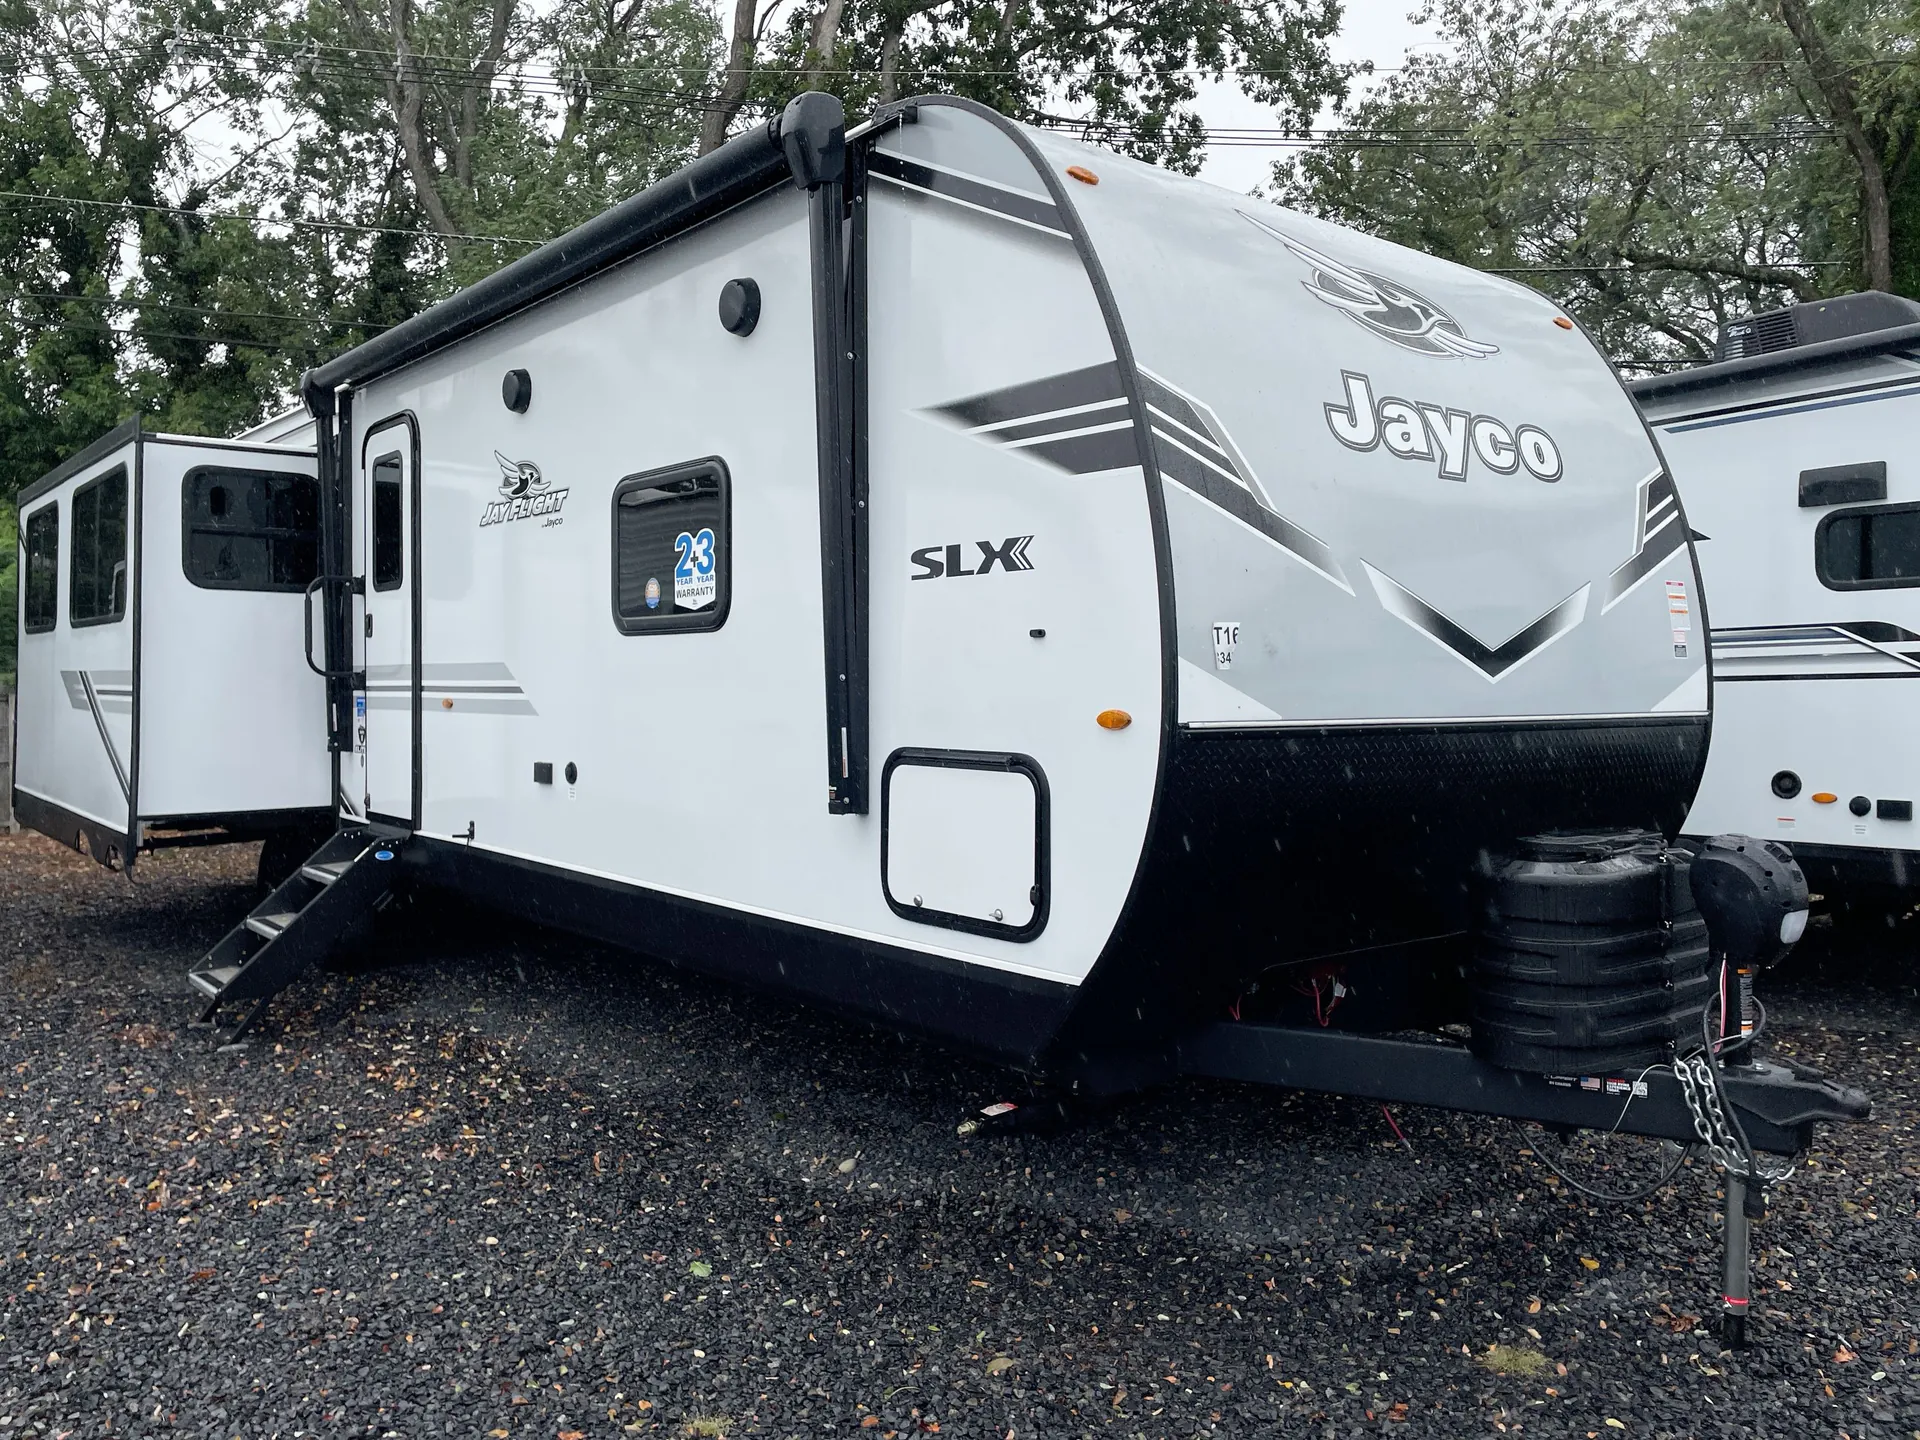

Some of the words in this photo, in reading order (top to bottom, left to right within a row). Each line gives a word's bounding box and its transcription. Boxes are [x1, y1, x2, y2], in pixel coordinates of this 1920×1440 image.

[1323, 369, 1563, 483] Jayco
[545, 518, 563, 528] Jayco
[911, 535, 1035, 580] SLX
[676, 578, 693, 586] YEAR
[697, 575, 714, 583] YEAR
[676, 586, 714, 599] WARRANTY
